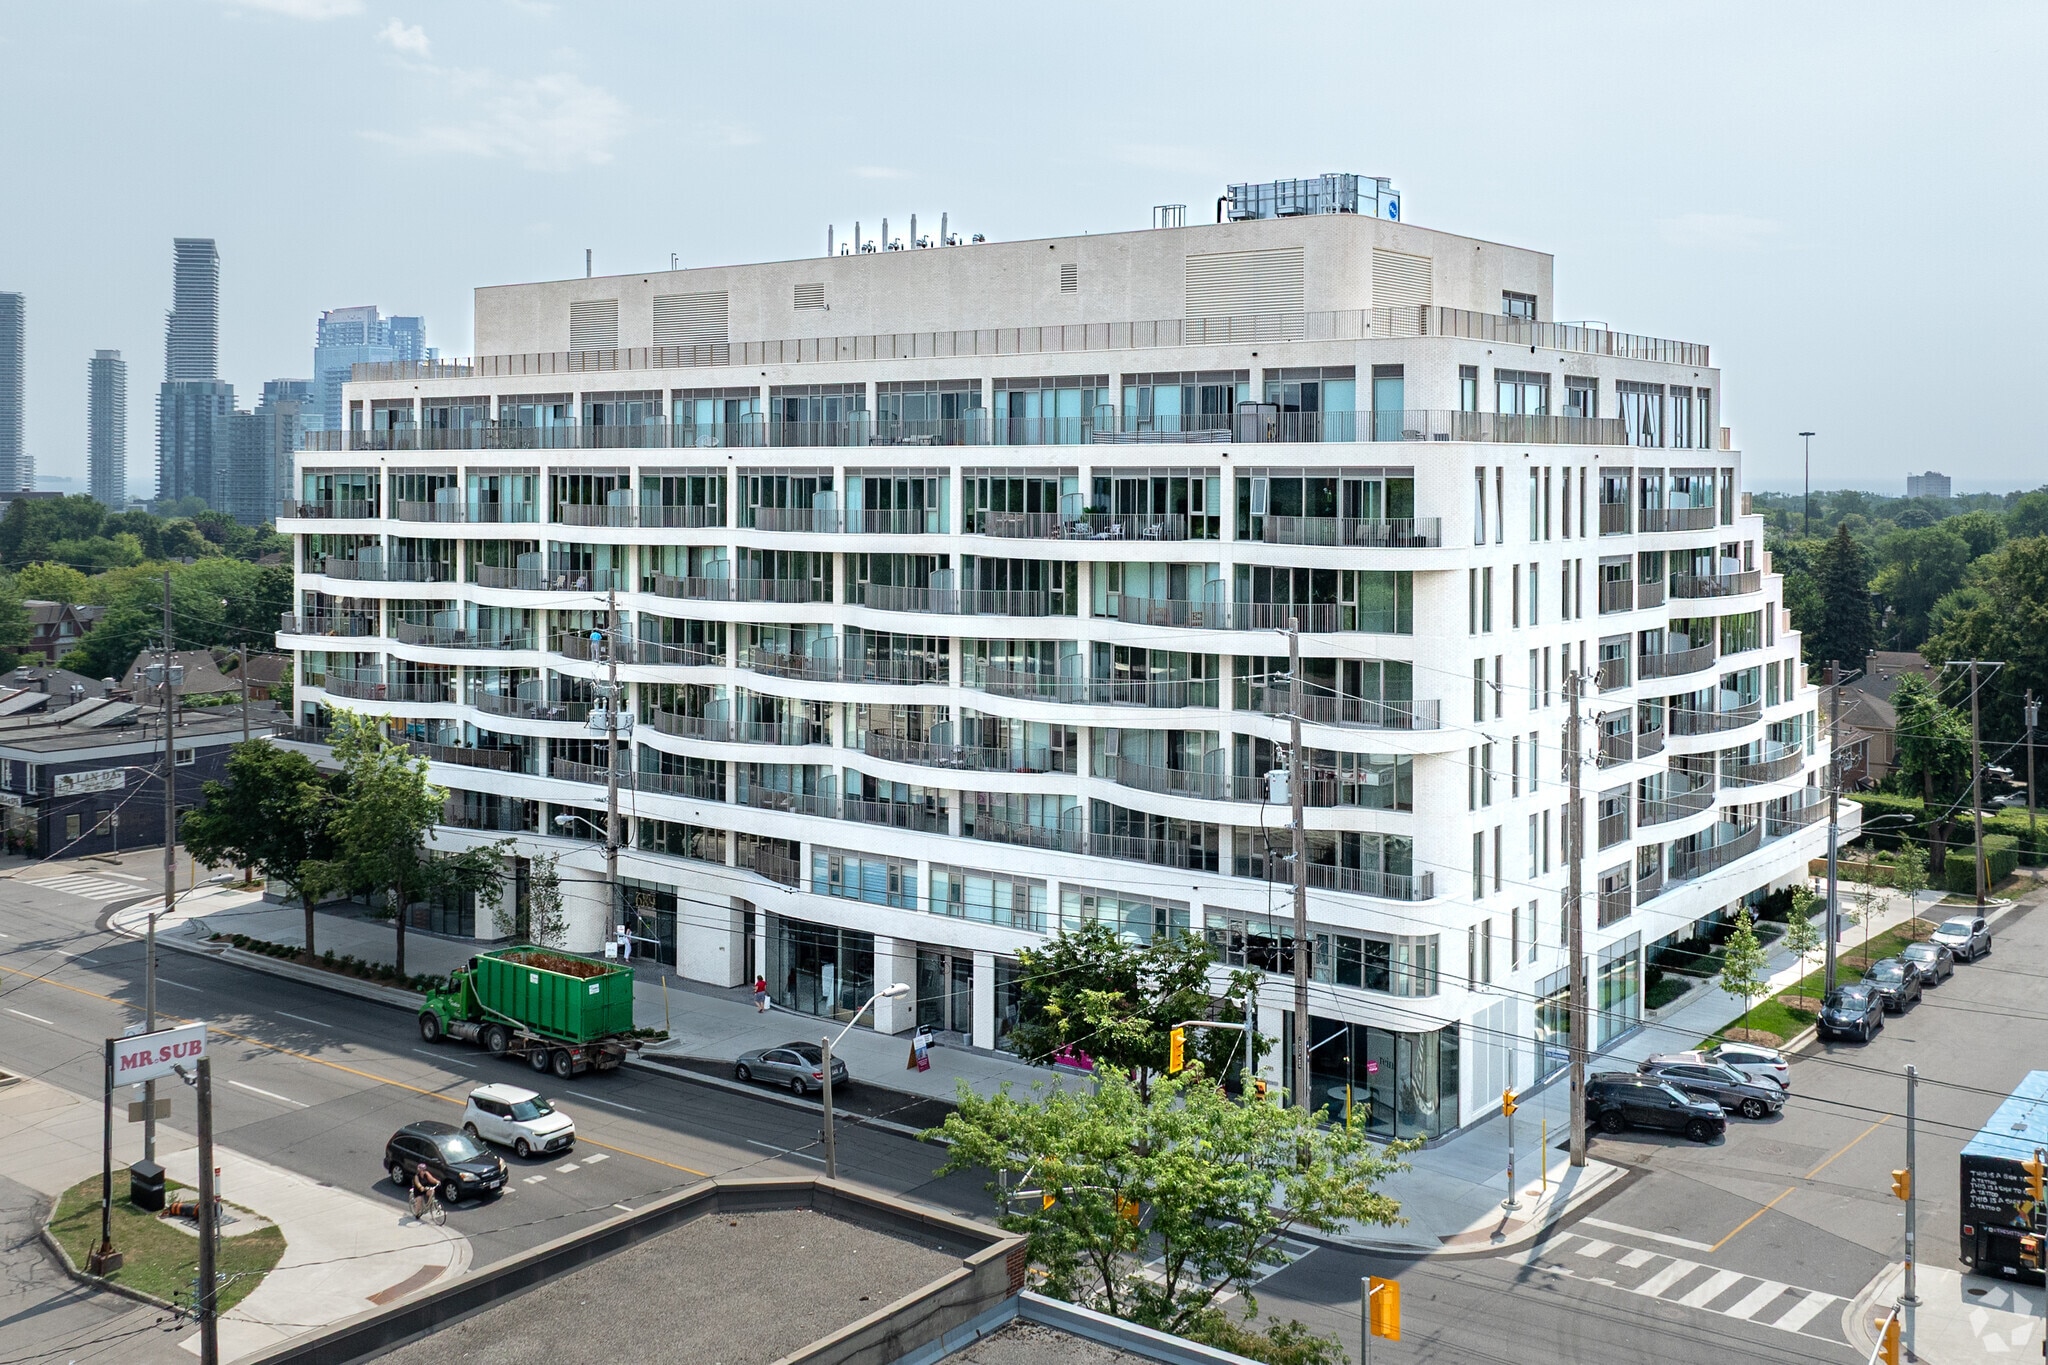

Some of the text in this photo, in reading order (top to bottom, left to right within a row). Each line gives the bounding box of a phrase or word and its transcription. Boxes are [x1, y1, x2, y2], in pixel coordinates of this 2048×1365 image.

[1970, 1170, 1987, 1178] THIS
[1970, 1182, 1987, 1190] THIS
[1977, 1190, 1999, 1198] TATTOO
[1970, 1195, 1988, 1203] THIS
